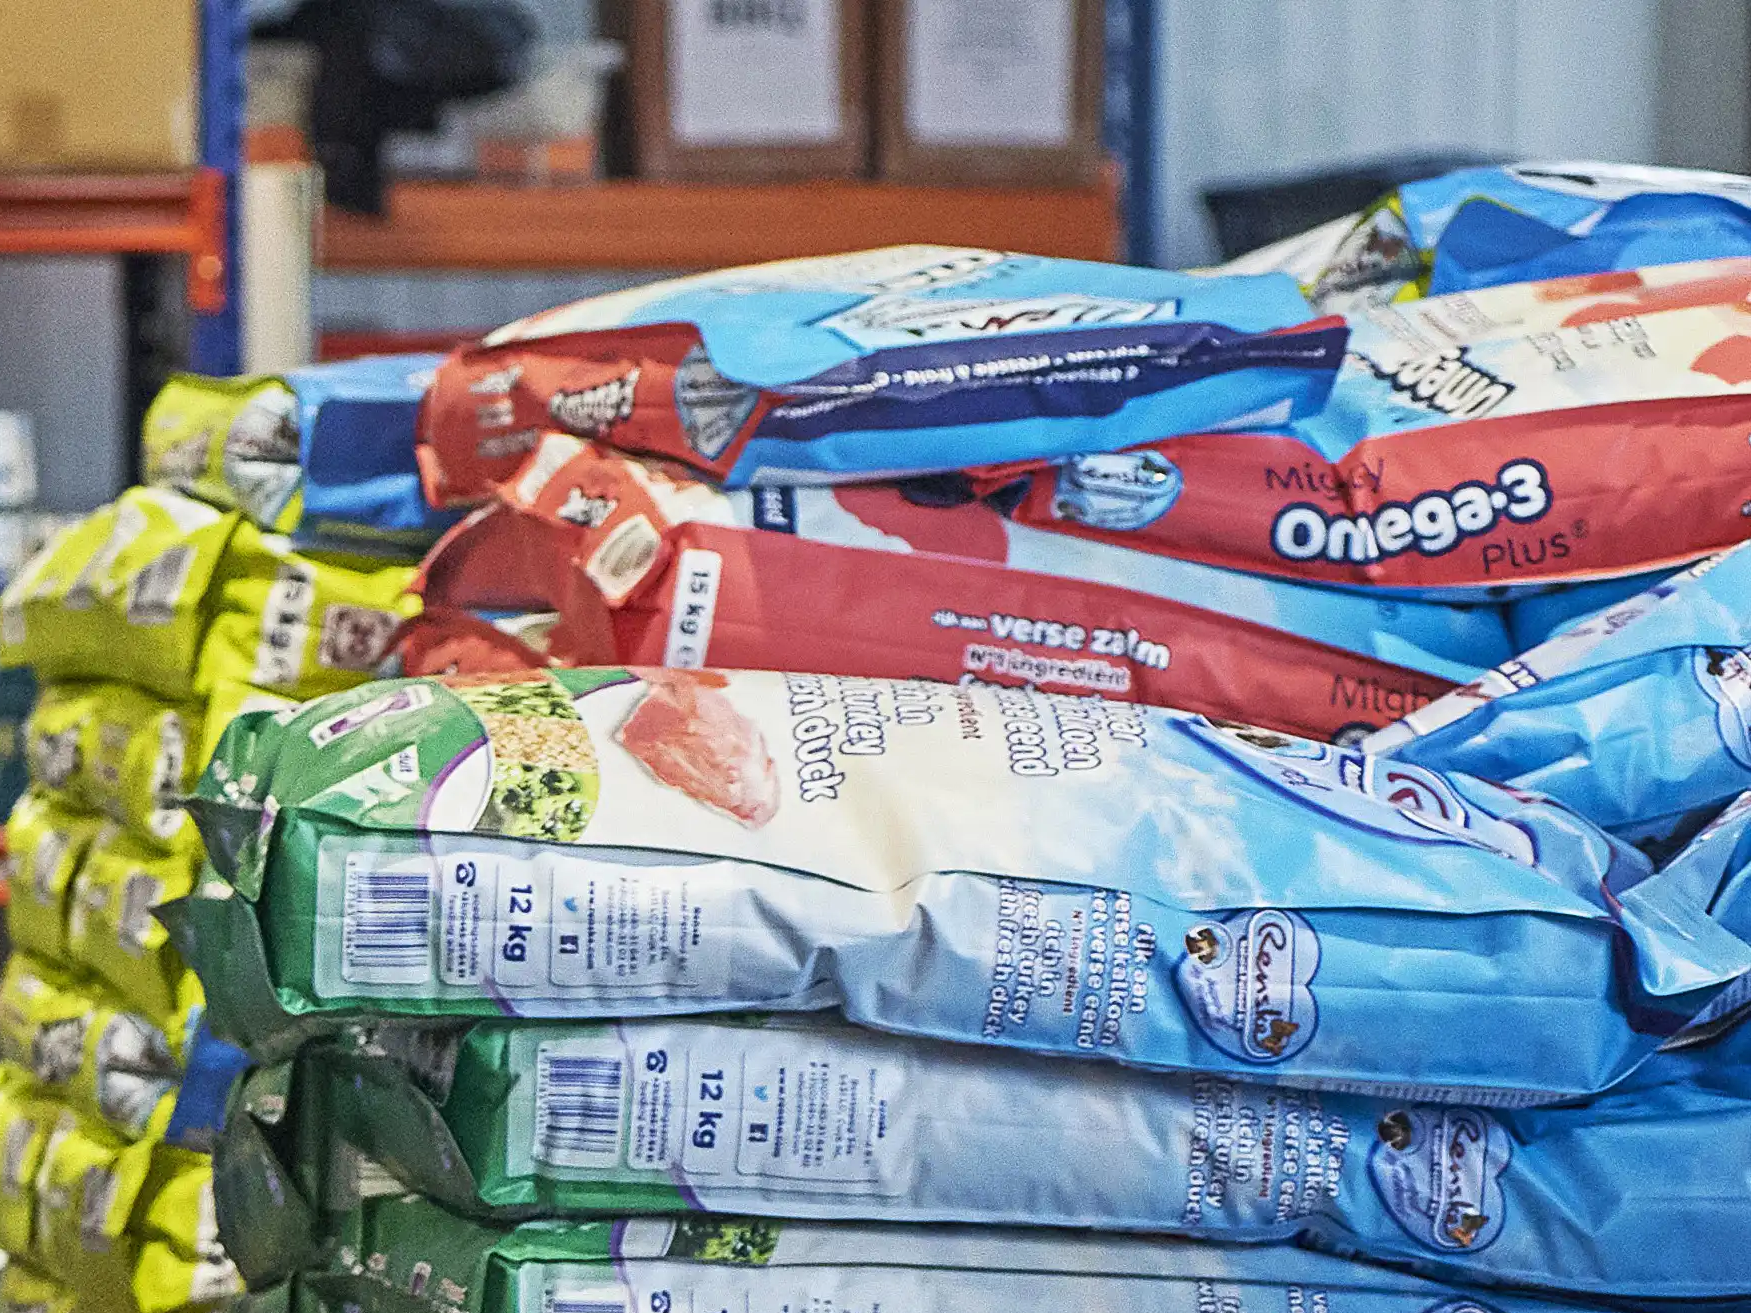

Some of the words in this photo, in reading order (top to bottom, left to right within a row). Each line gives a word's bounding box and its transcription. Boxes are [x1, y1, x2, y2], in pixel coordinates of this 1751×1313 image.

[990, 613, 1087, 652] verse
[1088, 622, 1173, 671] zalm
[1009, 653, 1130, 690] ingredient
[789, 713, 847, 803] duck
[1003, 720, 1059, 777] eend
[508, 884, 533, 914] 12
[501, 924, 534, 962] kg
[994, 920, 1018, 981] fresh
[1040, 920, 1066, 967] rich
[1087, 926, 1108, 990] verse
[1133, 923, 1155, 962] rijk
[1007, 949, 1037, 1026] turkey
[1039, 971, 1061, 998] in
[1100, 951, 1132, 1045] kalkoen
[1129, 968, 1149, 1012] aan
[982, 984, 1009, 1039] duck
[1076, 994, 1102, 1049] eend
[699, 1068, 725, 1102] 12
[692, 1110, 724, 1149] kg
[1237, 1107, 1259, 1154] rich
[1283, 1111, 1301, 1174] verse
[1326, 1155, 1342, 1198] aan
